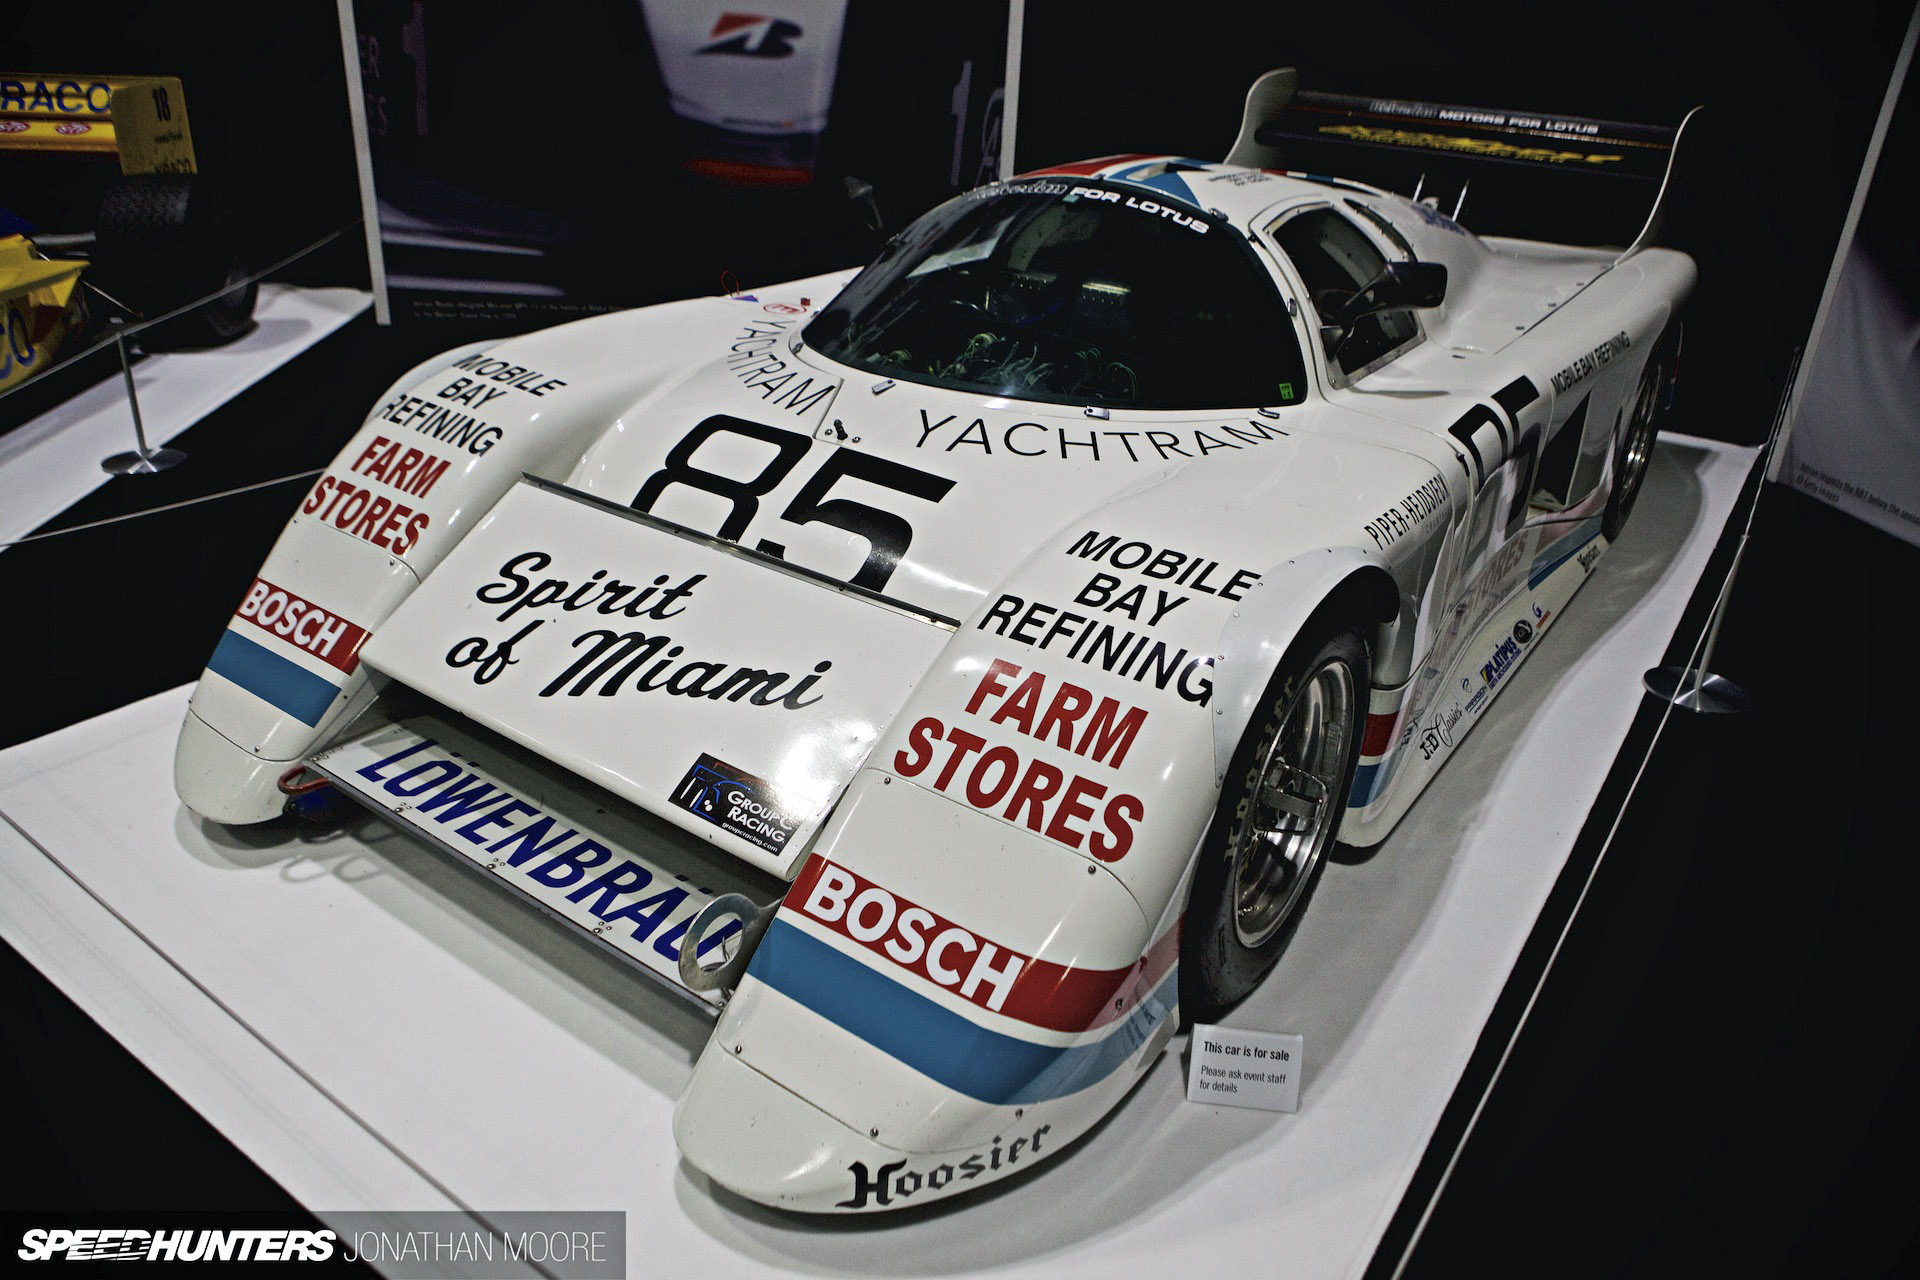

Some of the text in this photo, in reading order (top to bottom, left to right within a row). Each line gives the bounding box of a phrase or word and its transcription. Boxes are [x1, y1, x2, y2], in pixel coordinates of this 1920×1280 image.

[0, 80, 112, 113] RACO
[1439, 109, 1600, 135] MOTORS FOR LOTUS
[1069, 186, 1121, 204] FOR
[1125, 196, 1210, 234] LOTUS
[436, 377, 508, 409] BAY
[452, 353, 568, 397] MOBILE
[727, 319, 836, 416] YACHTRAM
[375, 393, 504, 457] REFINING
[916, 408, 1290, 463] YACHTRAM
[350, 435, 452, 499] FARM
[303, 475, 430, 556] STORES
[630, 413, 958, 593] 85
[475, 551, 708, 622] Spirit
[1065, 530, 1263, 602] MOBILE
[238, 580, 349, 658] BOSCH
[1073, 572, 1191, 627] BAY
[445, 619, 546, 686] of
[538, 629, 833, 710] Miami
[976, 593, 1216, 709] REFINING
[964, 657, 1150, 771] FARM
[727, 790, 795, 831] GROUP C
[893, 716, 1145, 864] STORES
[721, 821, 779, 853] groupcracing.com
[727, 805, 785, 843] RACING
[802, 863, 1026, 1013] BOSCH
[1200, 1064, 1287, 1085] Please ask event staff
[1203, 1040, 1290, 1062] This car is for sale
[1199, 1079, 1238, 1094] for details
[834, 1123, 1052, 1209] Hoosier
